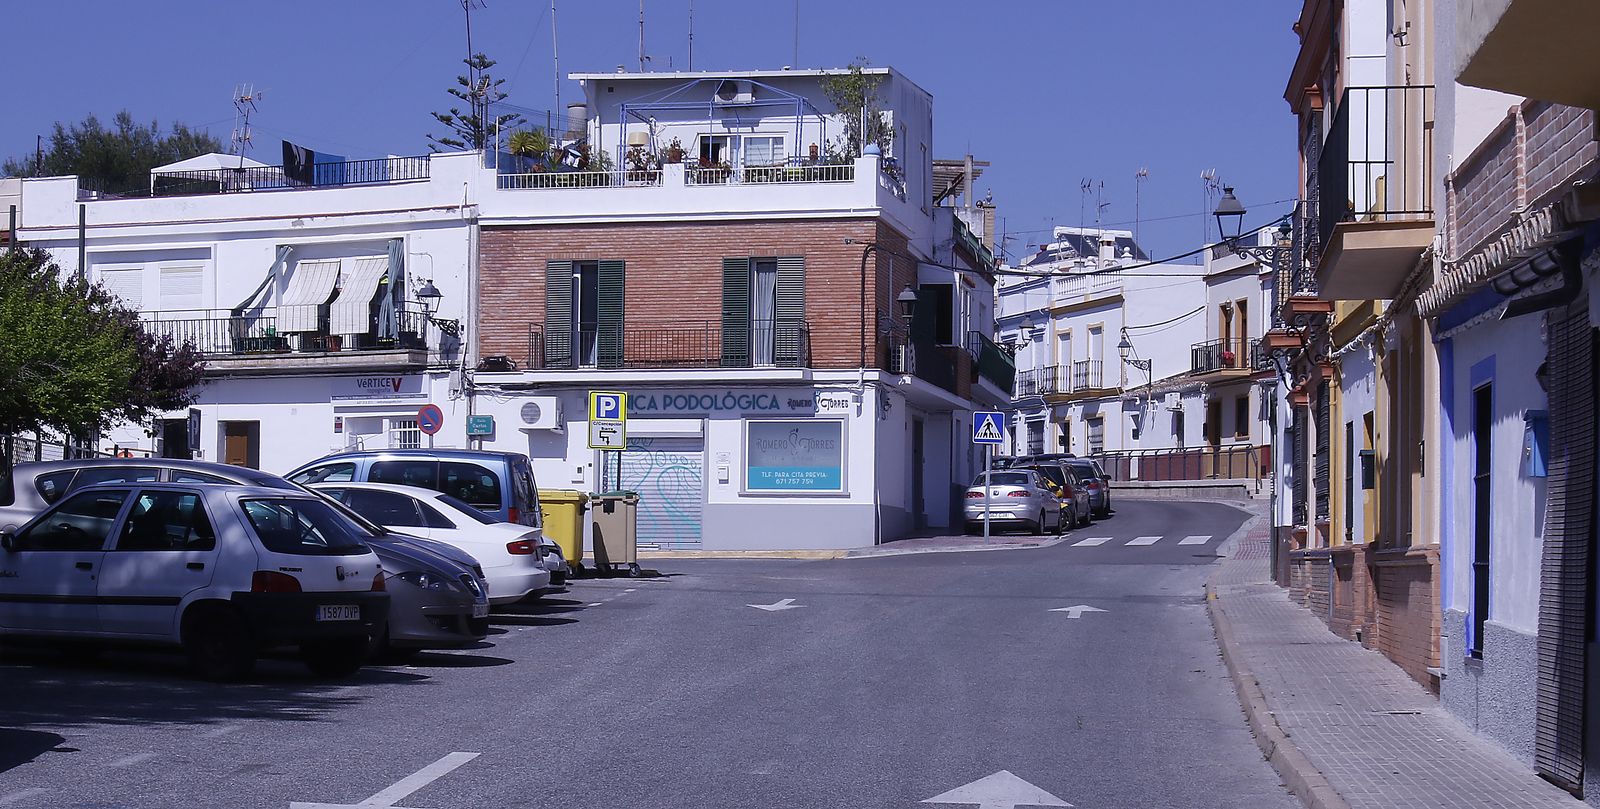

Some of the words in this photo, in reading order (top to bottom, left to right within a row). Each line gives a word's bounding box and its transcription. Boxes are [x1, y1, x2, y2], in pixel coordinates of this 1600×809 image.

[600, 396, 616, 417] P
[663, 391, 780, 410] PODOLÓGICA
[323, 606, 342, 619] 1587
[344, 606, 358, 619] DVP
